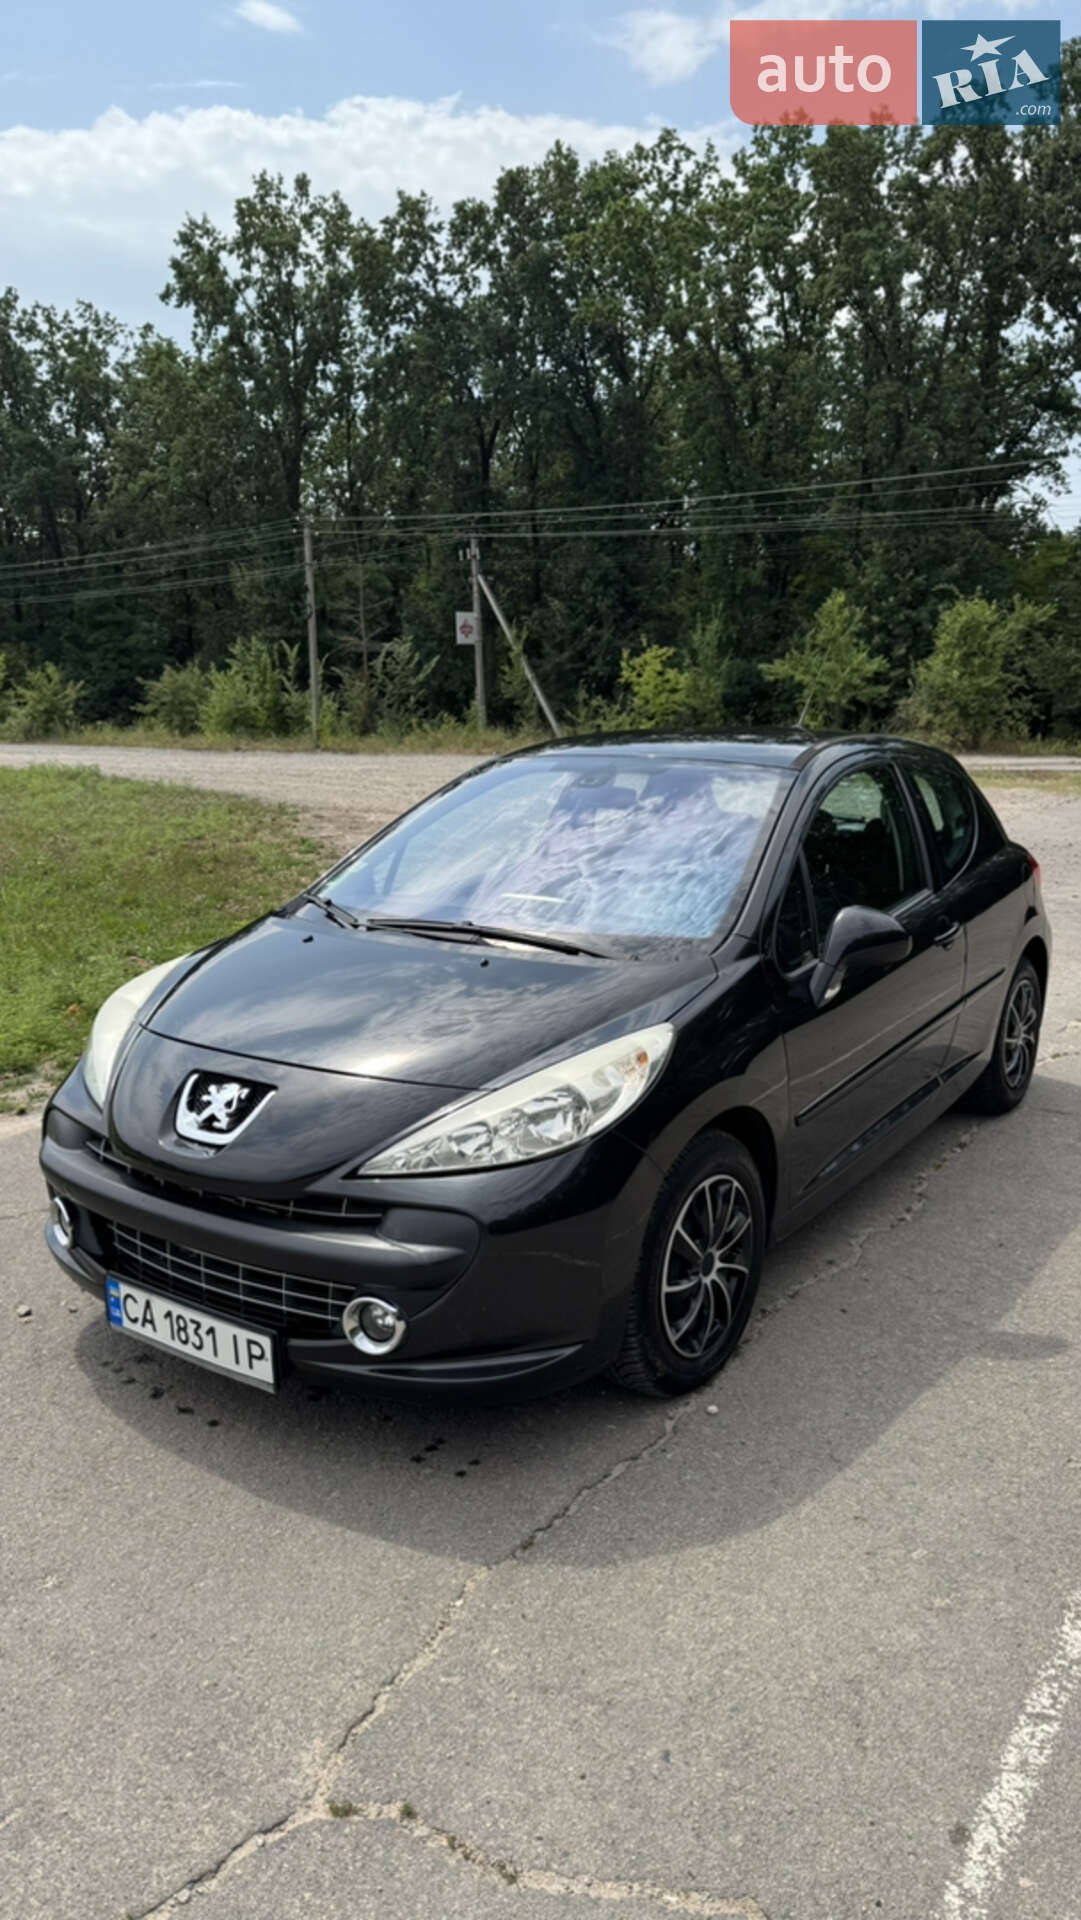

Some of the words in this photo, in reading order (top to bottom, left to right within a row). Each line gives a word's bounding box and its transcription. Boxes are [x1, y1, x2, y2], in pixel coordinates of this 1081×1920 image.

[122, 1293, 157, 1333] CA
[163, 1310, 218, 1358] 1831
[232, 1334, 266, 1370] IP
